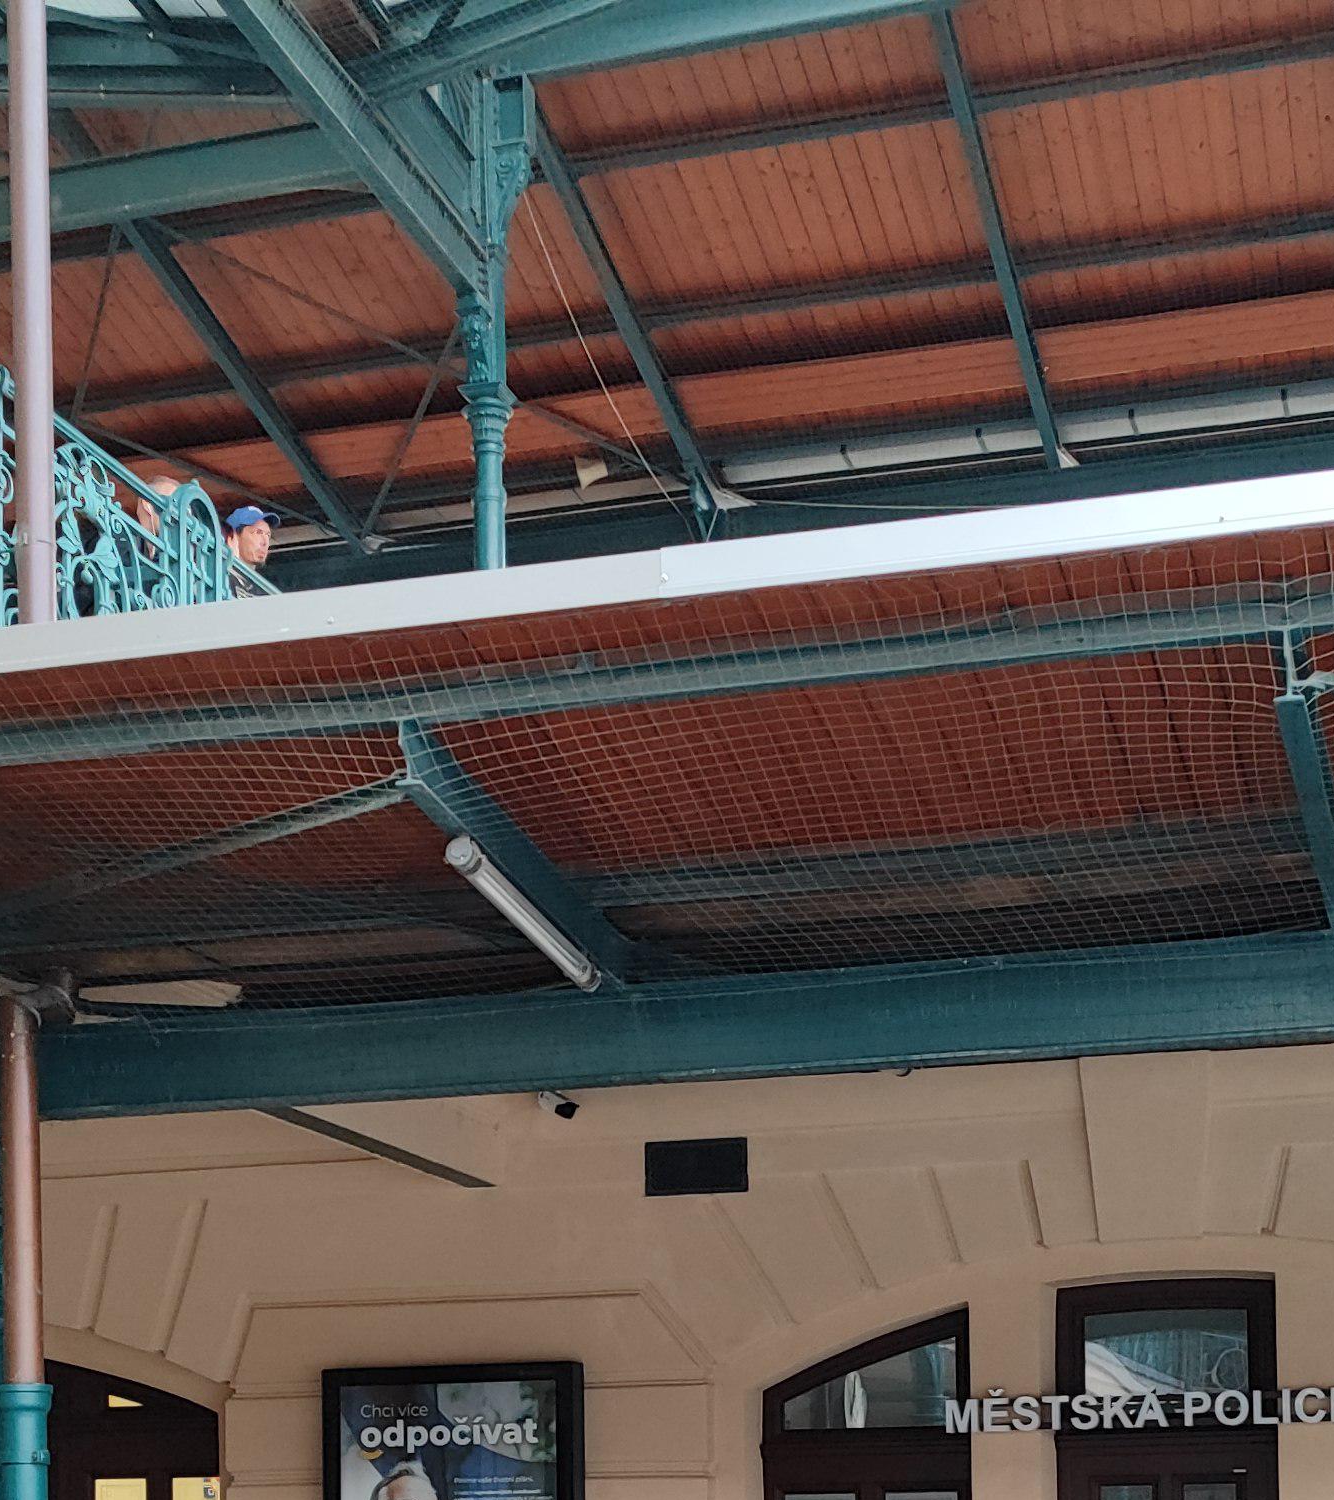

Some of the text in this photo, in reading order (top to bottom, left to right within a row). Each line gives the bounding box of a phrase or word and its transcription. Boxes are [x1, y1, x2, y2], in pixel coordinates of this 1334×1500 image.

[360, 1403, 429, 1418] Chci více
[945, 1388, 1169, 1434] MĚSTSKÁ
[360, 1416, 539, 1454] odpočívat
